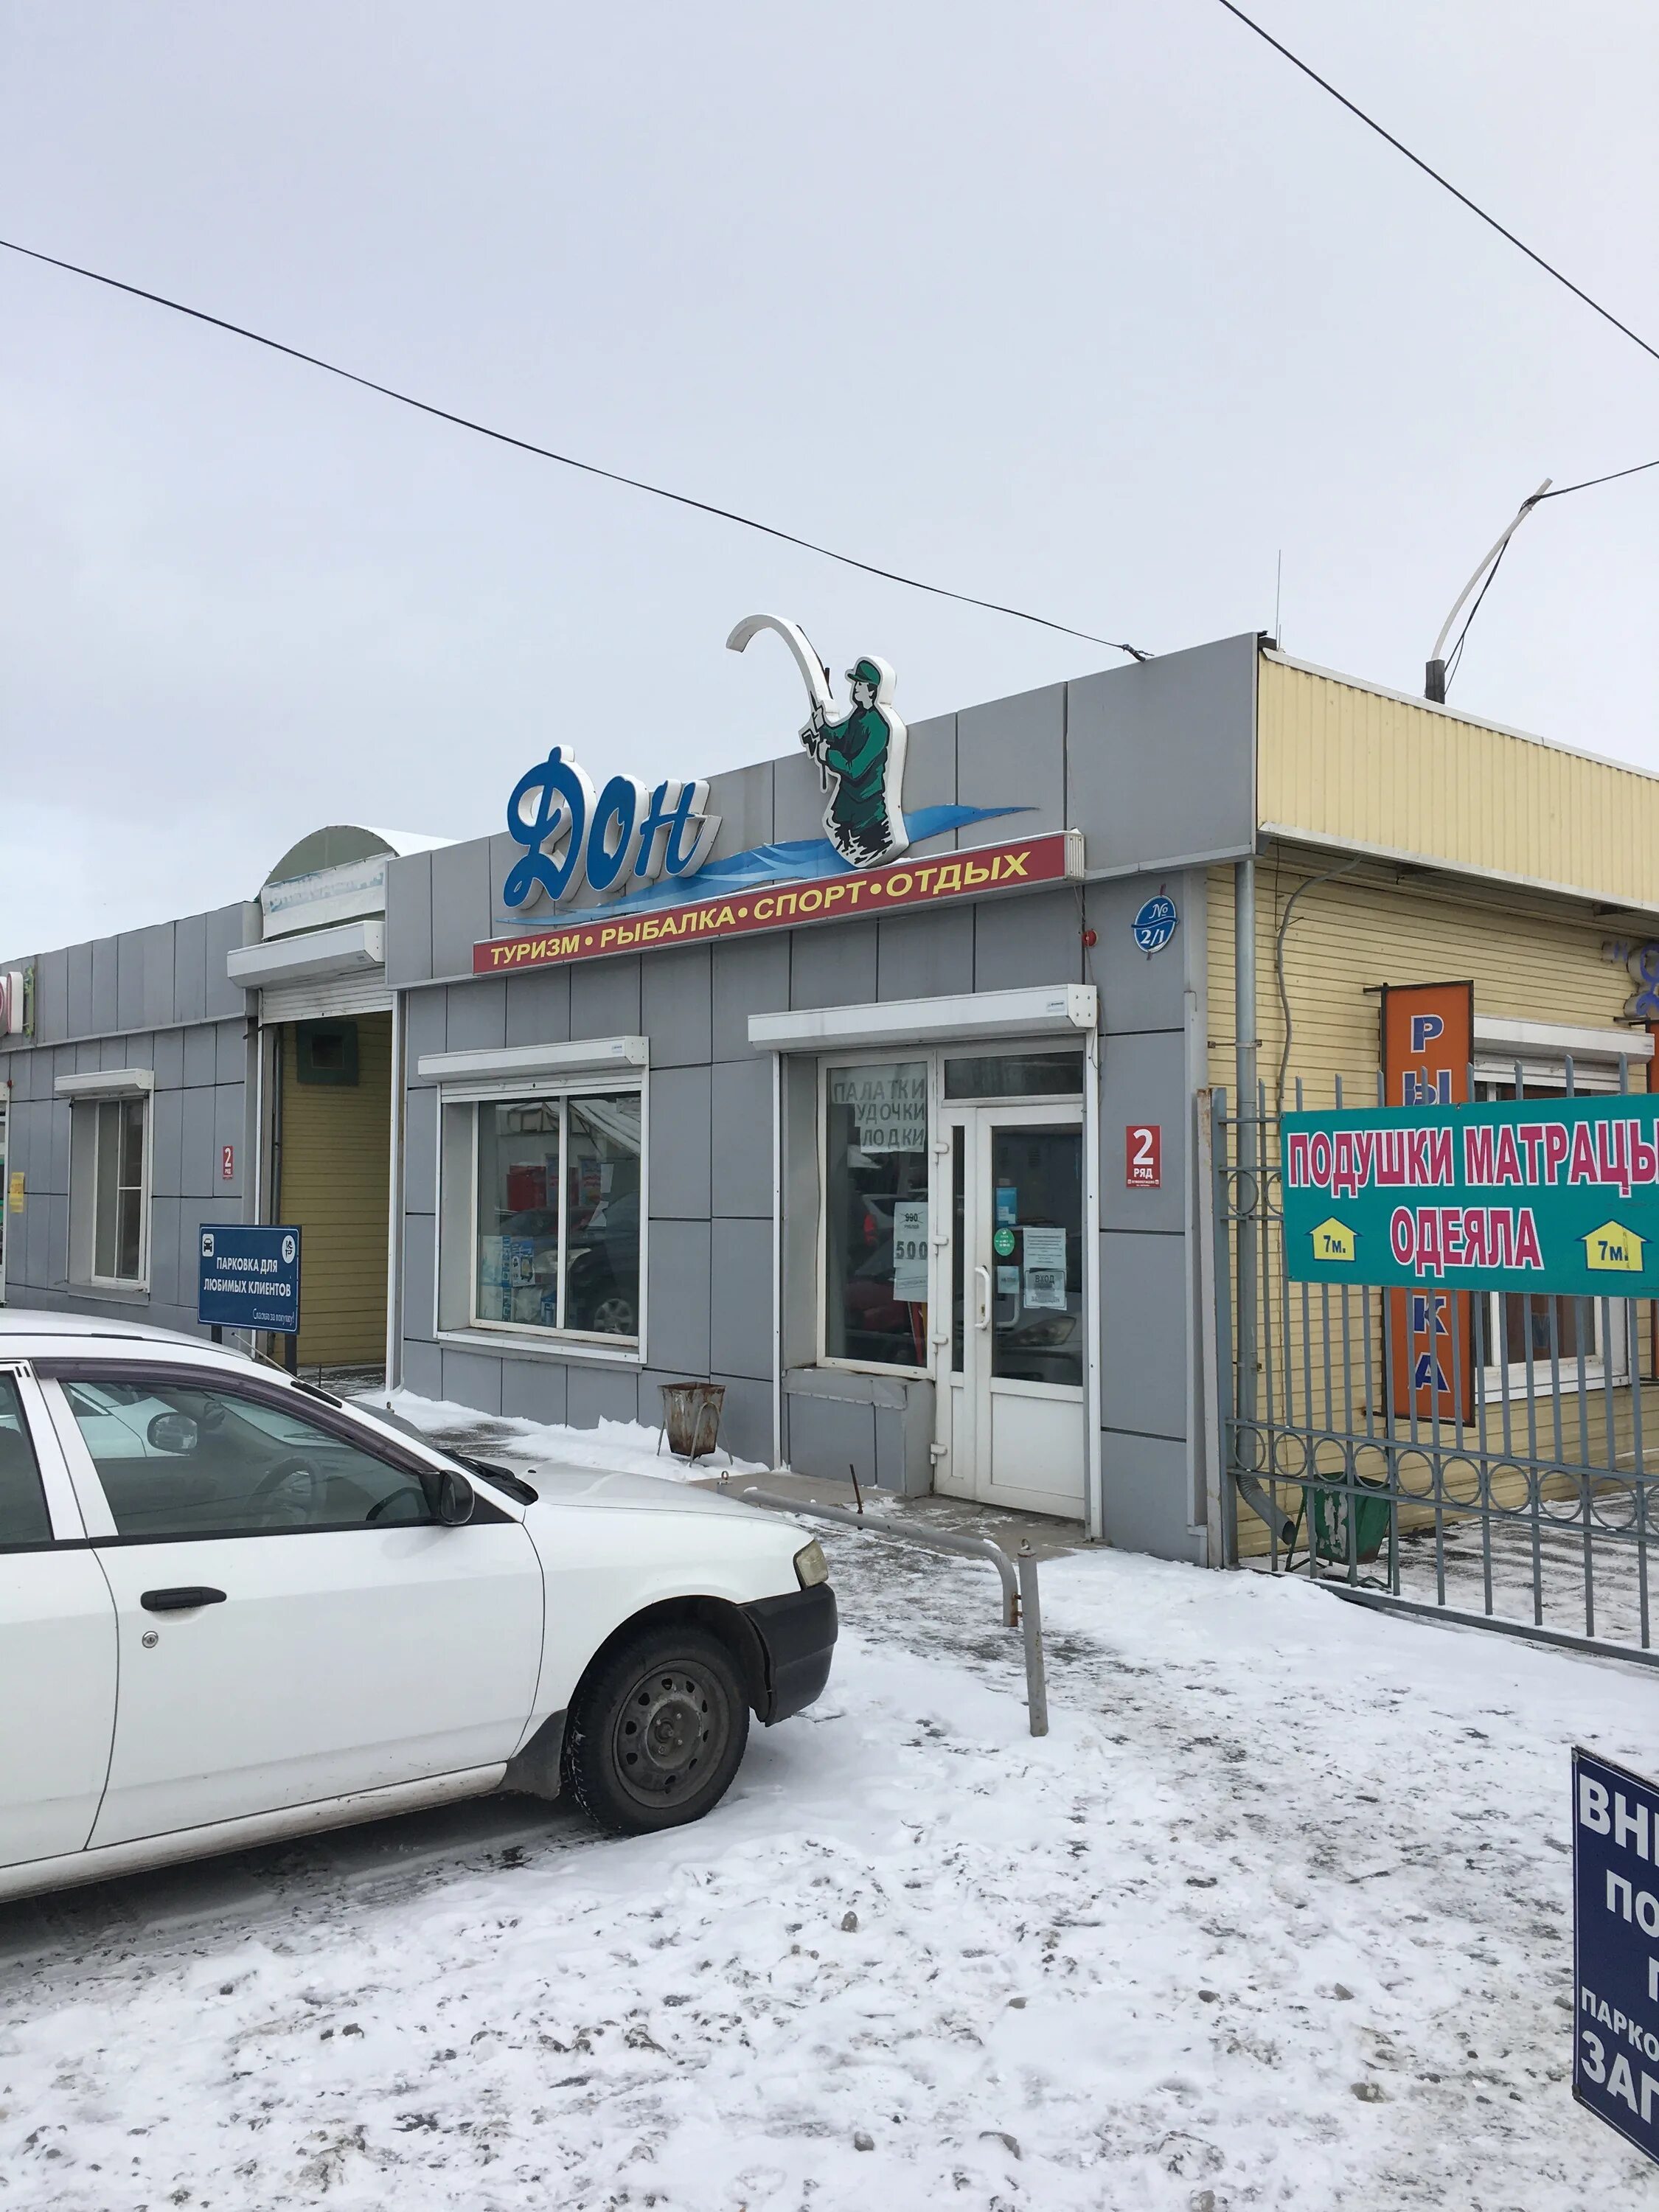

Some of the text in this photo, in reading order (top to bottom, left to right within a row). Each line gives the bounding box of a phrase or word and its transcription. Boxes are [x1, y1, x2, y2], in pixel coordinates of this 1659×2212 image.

[490, 851, 1032, 965] ТУРИЗМ РЫБАЛКА СПОРТ ОТДЫХ
[1140, 929, 1165, 946] 2/1
[834, 1079, 925, 1102] ПАЛАТКИ
[857, 1103, 925, 1124] УДОЧКИ
[863, 1128, 925, 1149] ЛОДКИ
[1133, 1129, 1153, 1165] 2
[225, 1147, 232, 1167] 2
[1287, 1119, 1659, 1199] ПОДУШКИ МАТРАЦЫ
[1134, 1168, 1152, 1179] РЯД
[905, 1213, 918, 1222] 990
[897, 1241, 928, 1260] 500
[1390, 1206, 1545, 1279] ОДЕЯЛА
[216, 1257, 277, 1275] ПАРКОВКА ДЛЯ
[204, 1278, 291, 1297] ЛЮБИМЫХ КЛИЕНТОВ
[1035, 1275, 1055, 1284] ВХОД
[1579, 1773, 1659, 1868] ВН
